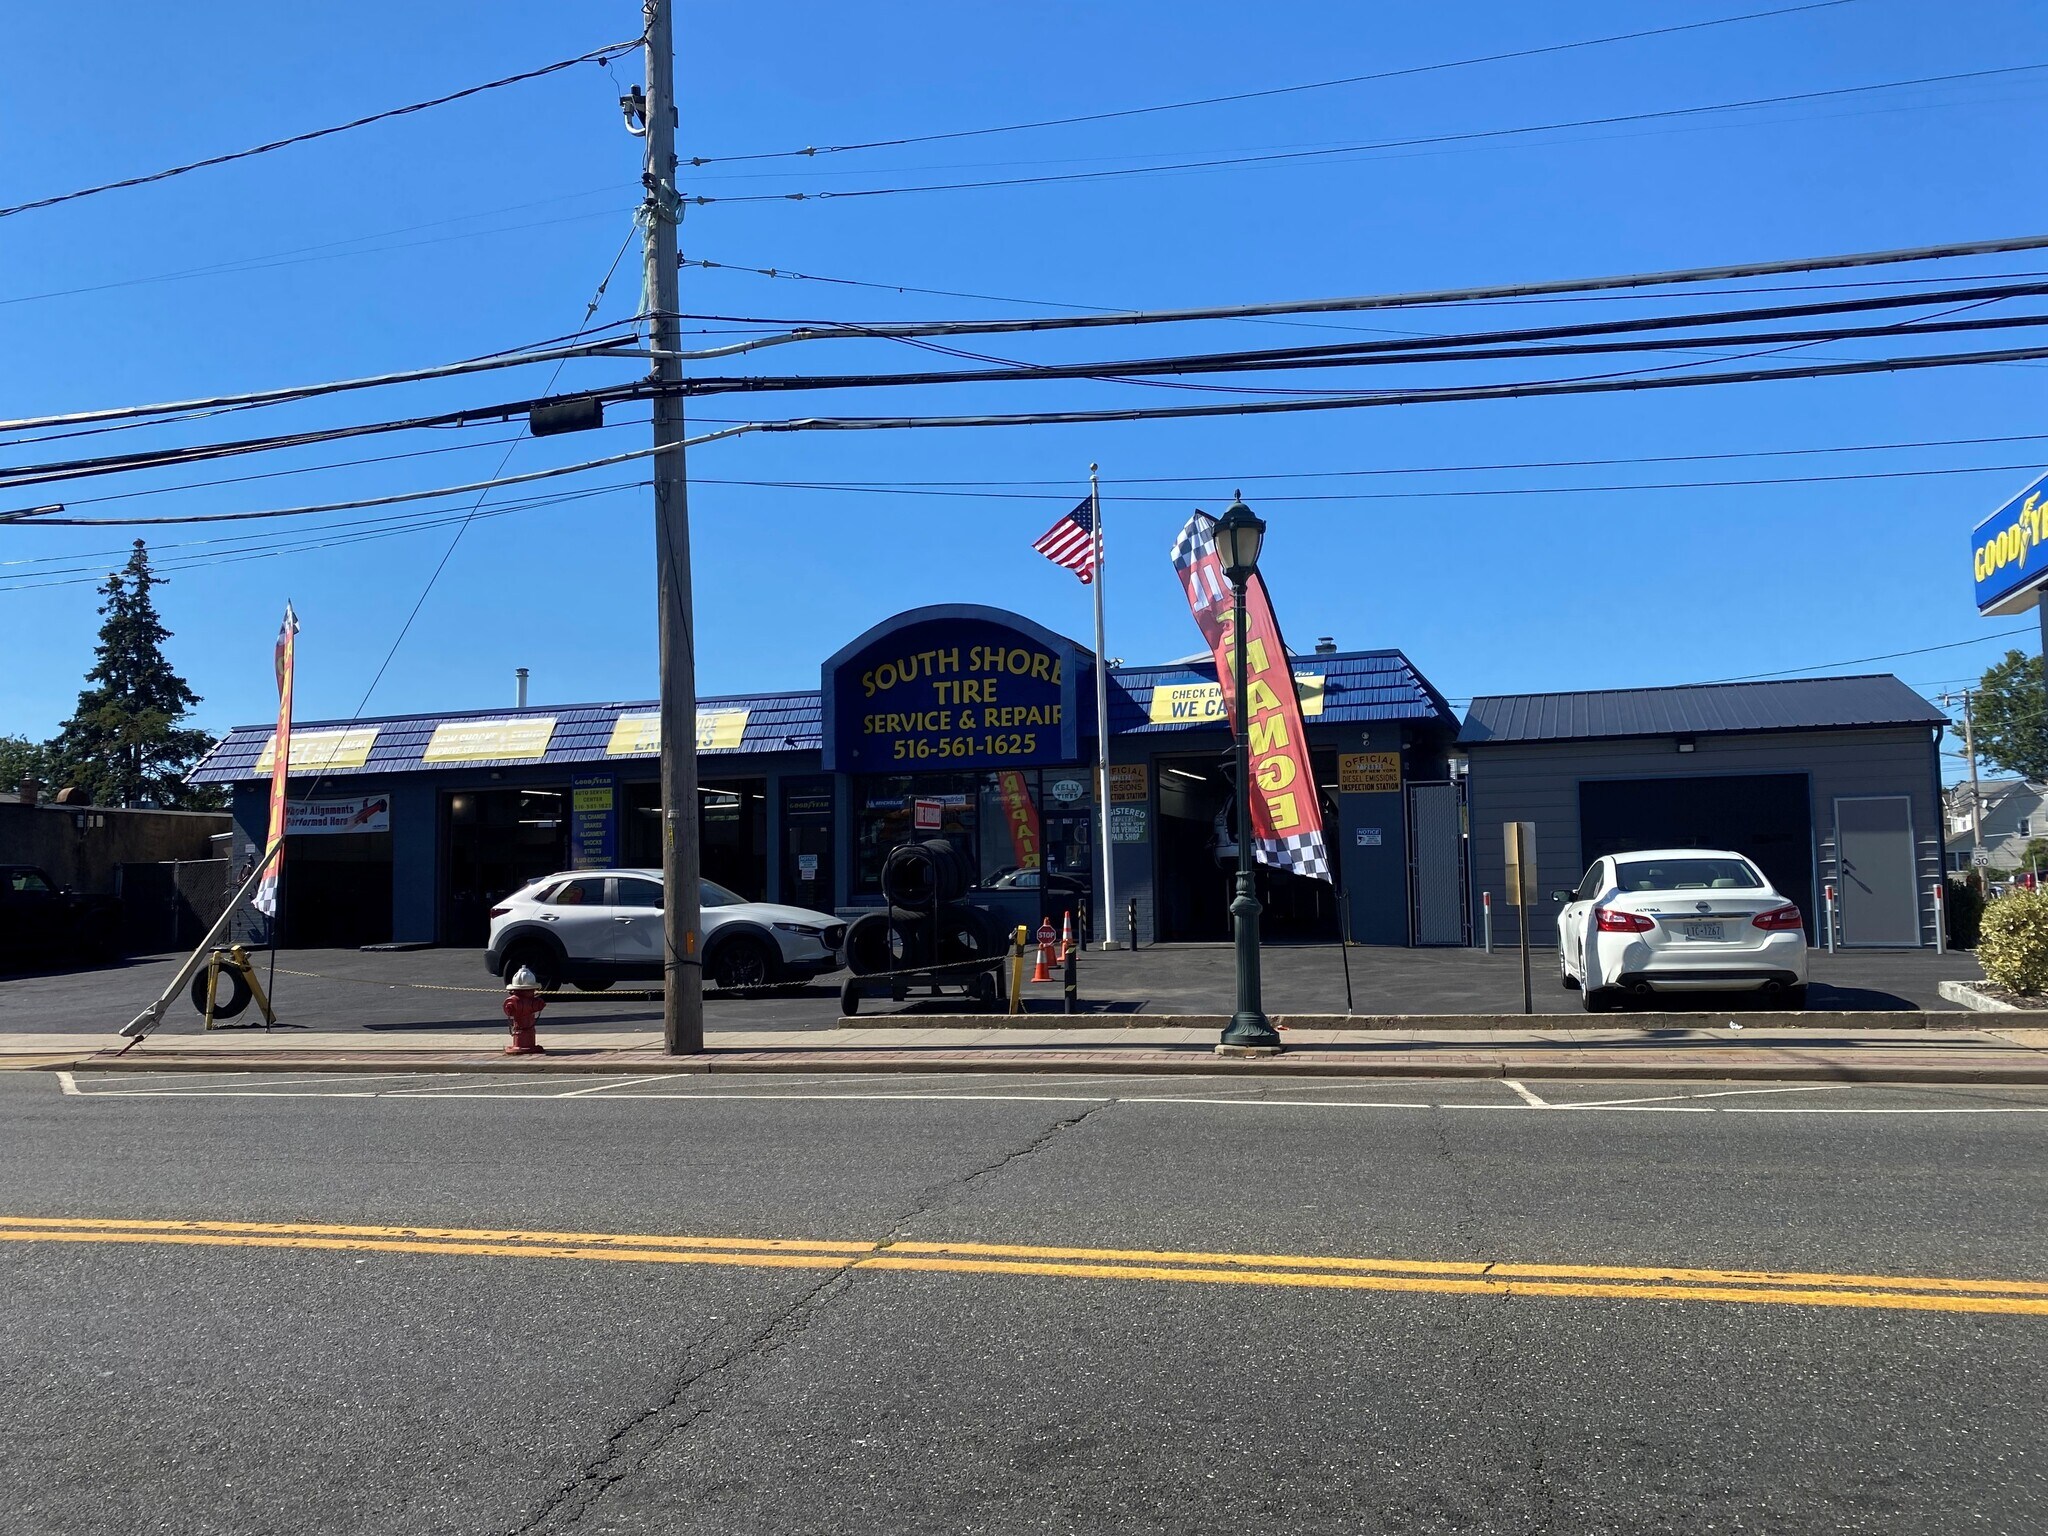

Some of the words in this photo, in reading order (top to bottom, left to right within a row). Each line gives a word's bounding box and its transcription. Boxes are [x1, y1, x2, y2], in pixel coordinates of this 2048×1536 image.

[862, 647, 959, 698] SOUTH
[969, 645, 1061, 686] SHORE
[932, 677, 998, 705] TIRE
[1172, 688, 1205, 700] CHECK
[1172, 700, 1199, 718] WE
[863, 710, 952, 735] SERVICE
[958, 709, 977, 730] &
[984, 704, 1061, 728] REPAIR
[893, 733, 1037, 760] 516-561-1625
[1345, 755, 1395, 768] OFFICIAL
[1342, 774, 1363, 783] DIESEL
[1365, 773, 1398, 782] EMISSIONS
[1055, 783, 1080, 791] KELLY
[1341, 783, 1375, 791] INSPECTION
[1375, 782, 1399, 790] STATION
[1126, 792, 1147, 800] STATION
[310, 804, 354, 816] Alignments
[1121, 825, 1144, 833] VEHICLE
[1975, 857, 1988, 865] 30
[1038, 931, 1055, 939] STOP
